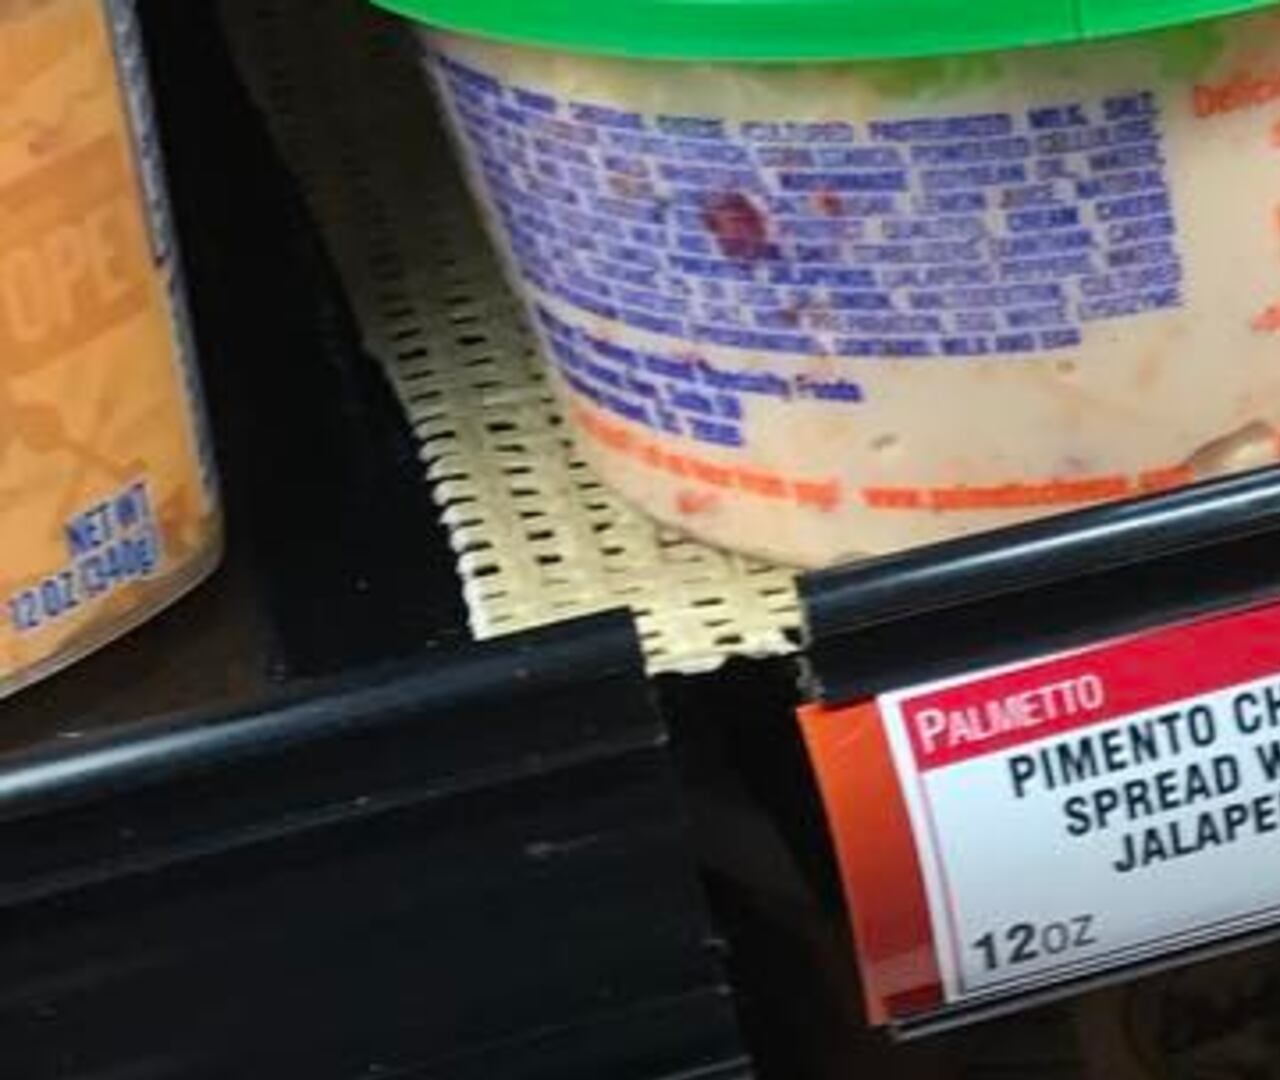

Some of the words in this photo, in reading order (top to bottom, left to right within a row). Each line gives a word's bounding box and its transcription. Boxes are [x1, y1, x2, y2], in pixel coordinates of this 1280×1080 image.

[917, 674, 1103, 752] PALMETTO
[1008, 704, 1216, 800] PIMENTO
[1064, 752, 1242, 837] SPREAD
[976, 914, 1098, 971] 12oz
